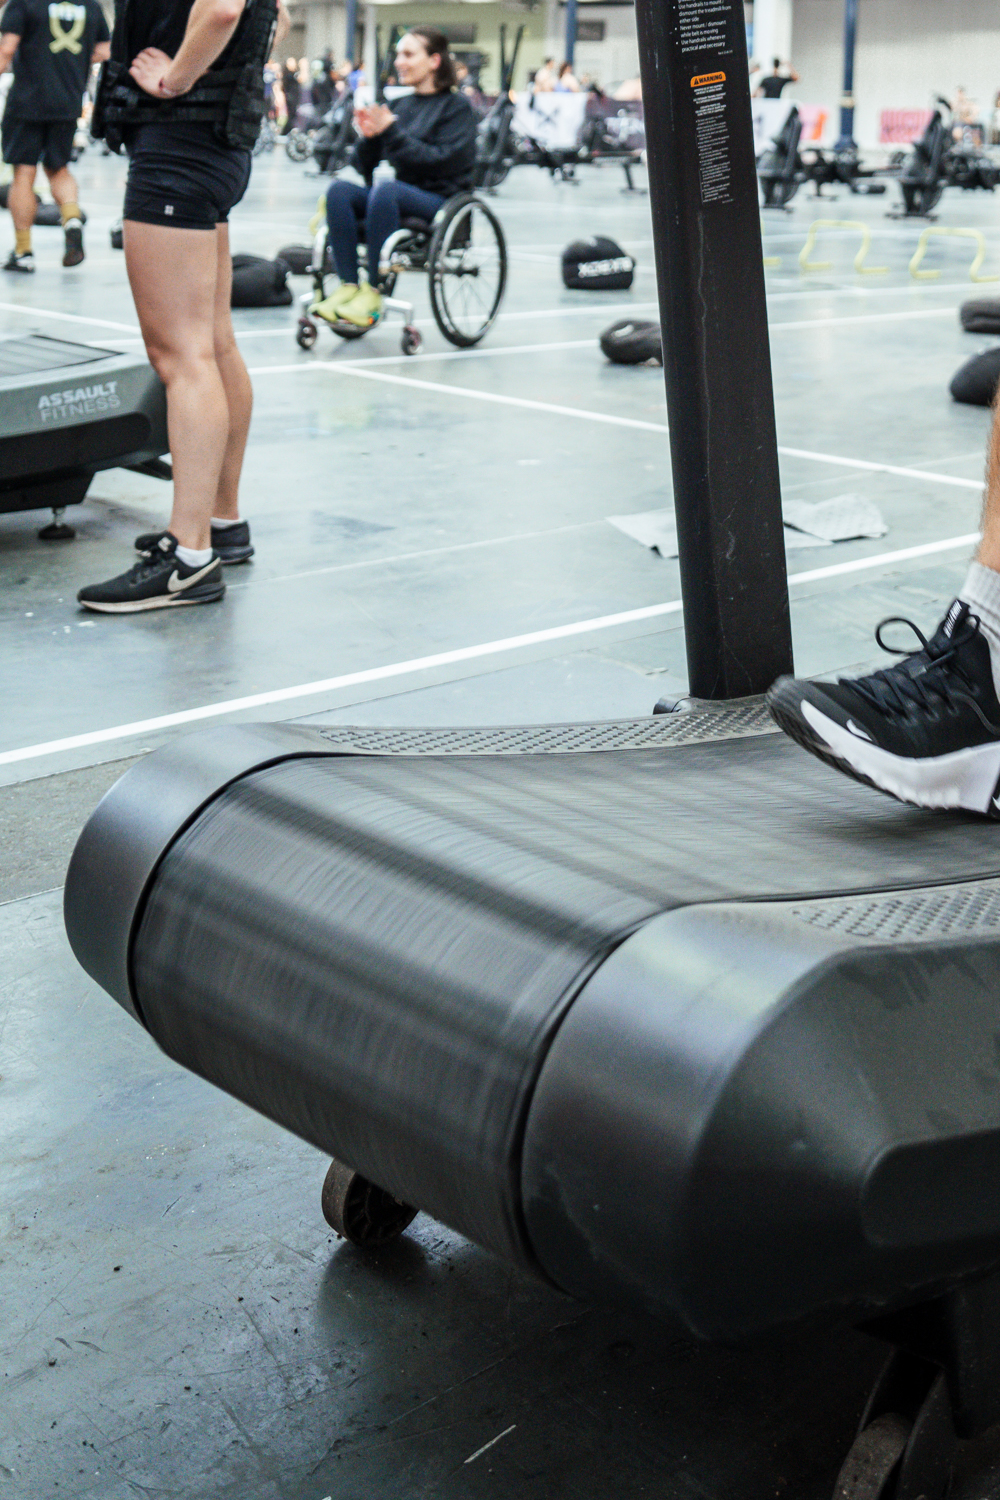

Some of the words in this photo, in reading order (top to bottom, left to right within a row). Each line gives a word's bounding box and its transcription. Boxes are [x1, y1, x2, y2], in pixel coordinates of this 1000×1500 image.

[682, 45, 698, 53] practical
[699, 74, 722, 84] WARNING
[38, 381, 118, 409] ASSAULT
[40, 394, 121, 422] FITNESS
